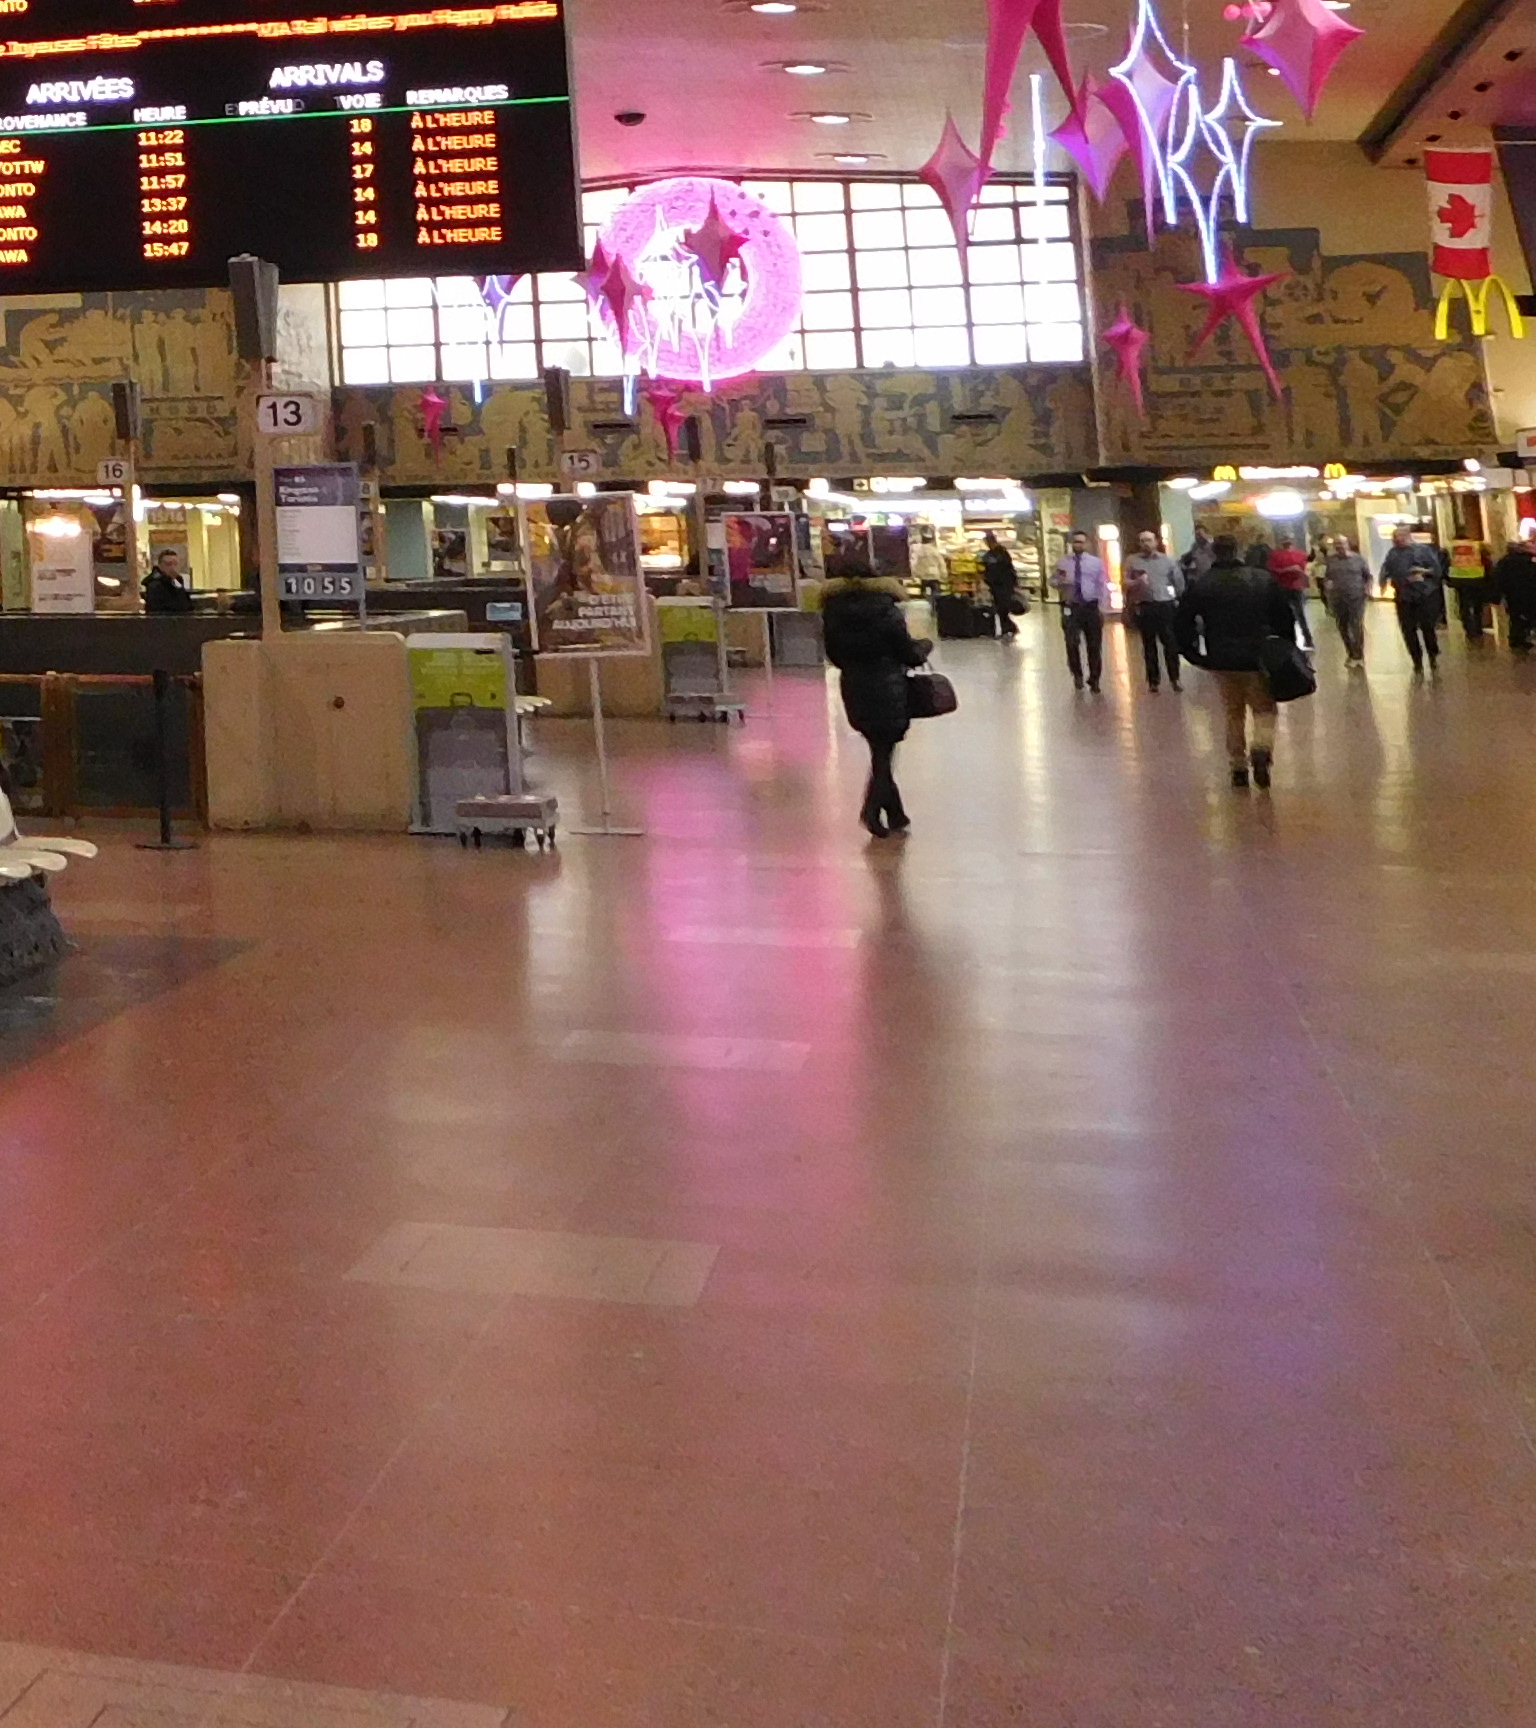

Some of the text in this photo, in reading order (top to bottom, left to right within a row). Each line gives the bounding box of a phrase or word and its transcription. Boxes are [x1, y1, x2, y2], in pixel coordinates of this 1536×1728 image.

[26, 75, 135, 104] ARRIVÉES
[269, 60, 385, 89] ARRIVALS
[134, 106, 186, 123] HEURE
[406, 84, 509, 106] REMARQUES
[138, 130, 185, 146] 11:22
[410, 113, 424, 130] À
[139, 152, 186, 168] 11:51
[351, 141, 373, 157] 14
[411, 136, 425, 154] À
[140, 174, 186, 192] 11:57
[352, 164, 375, 180] 17
[413, 159, 427, 176] À
[141, 196, 188, 214] 13:37
[353, 186, 376, 202] 14
[414, 182, 428, 200] À
[142, 219, 189, 236] 14:20
[354, 209, 377, 225] 14
[415, 204, 429, 222] À
[143, 241, 190, 259] 15:47
[417, 227, 431, 245] À
[266, 400, 303, 427] 13
[104, 462, 124, 480] 16
[568, 455, 590, 471] 15
[286, 577, 353, 595] 1055
